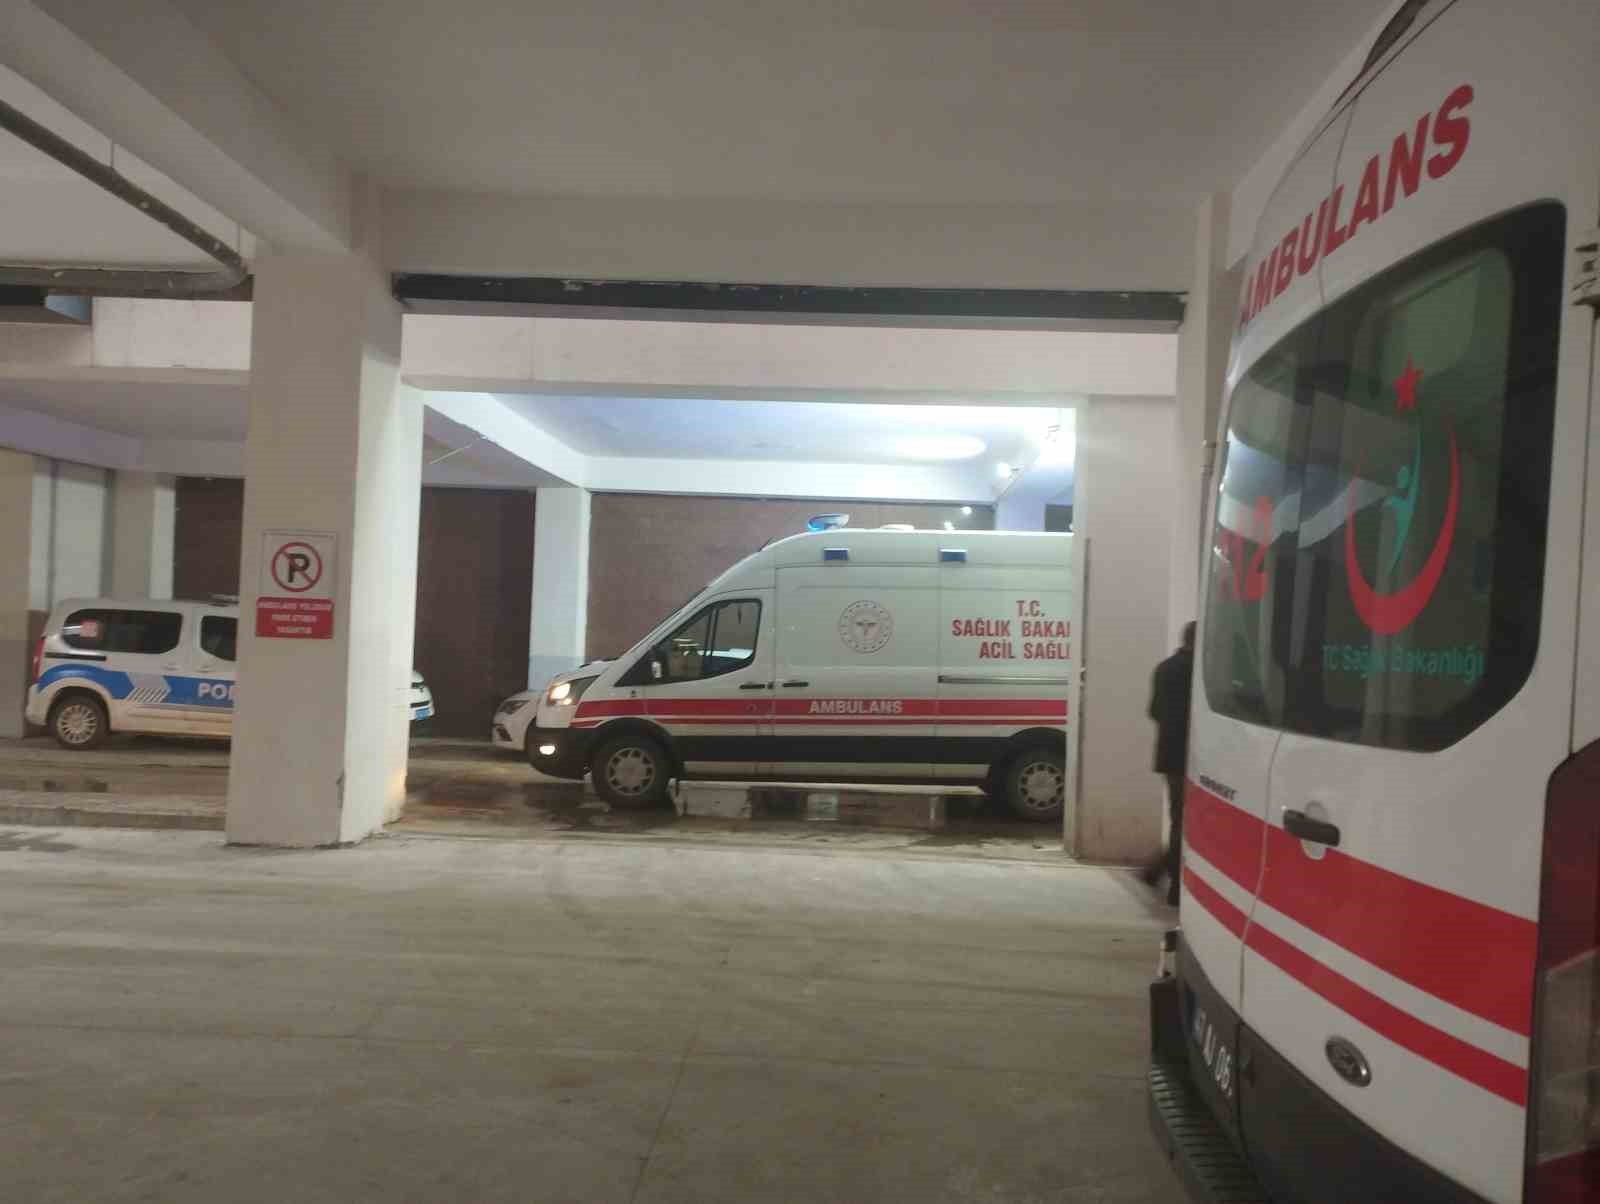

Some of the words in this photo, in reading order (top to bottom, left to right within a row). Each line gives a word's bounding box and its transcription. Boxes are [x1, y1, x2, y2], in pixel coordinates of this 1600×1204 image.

[1239, 83, 1475, 330] AMBULANS
[1016, 600, 1045, 618] T.C.
[952, 617, 1011, 637] SAĞLIK
[979, 638, 1017, 660] ACİL
[808, 699, 905, 715] AMBULANS
